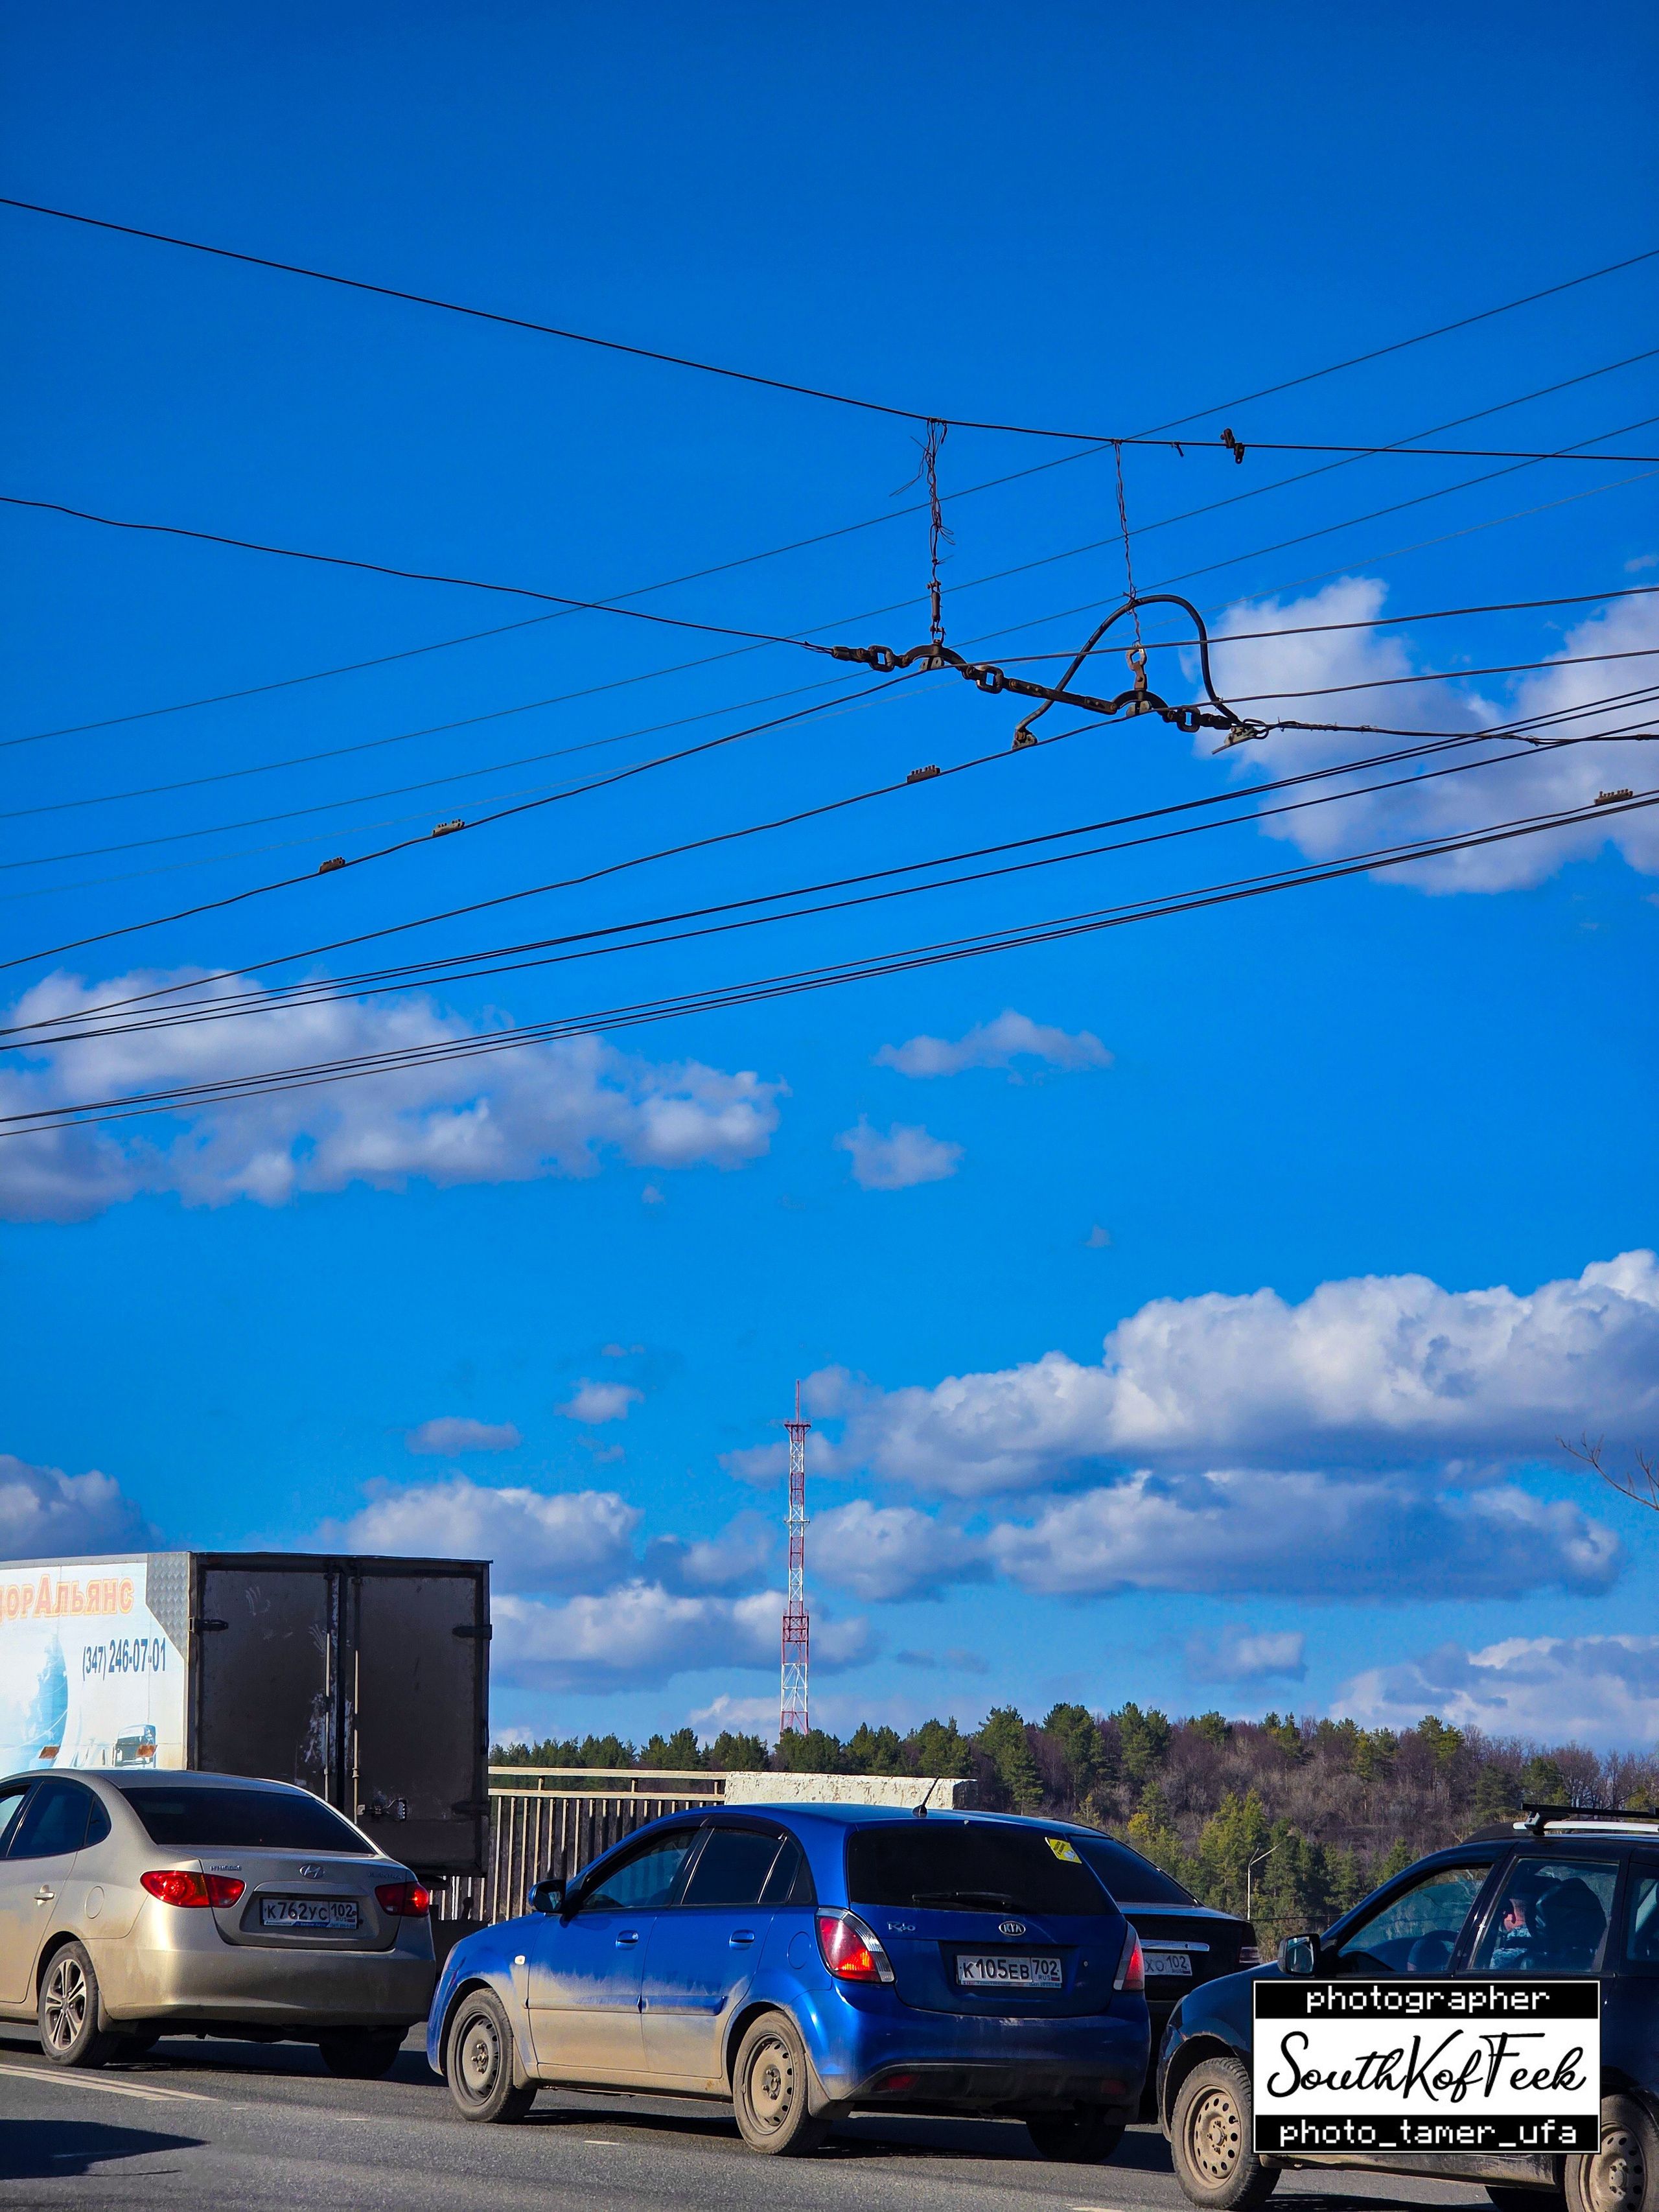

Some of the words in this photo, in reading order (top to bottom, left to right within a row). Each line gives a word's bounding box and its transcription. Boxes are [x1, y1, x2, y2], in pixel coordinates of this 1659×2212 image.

[82, 1646, 106, 1681] (347)
[108, 1637, 166, 1673] 246-07-01
[331, 1903, 353, 1918] 102
[1032, 1959, 1058, 1975] 702
[1166, 1955, 1187, 1970] 102
